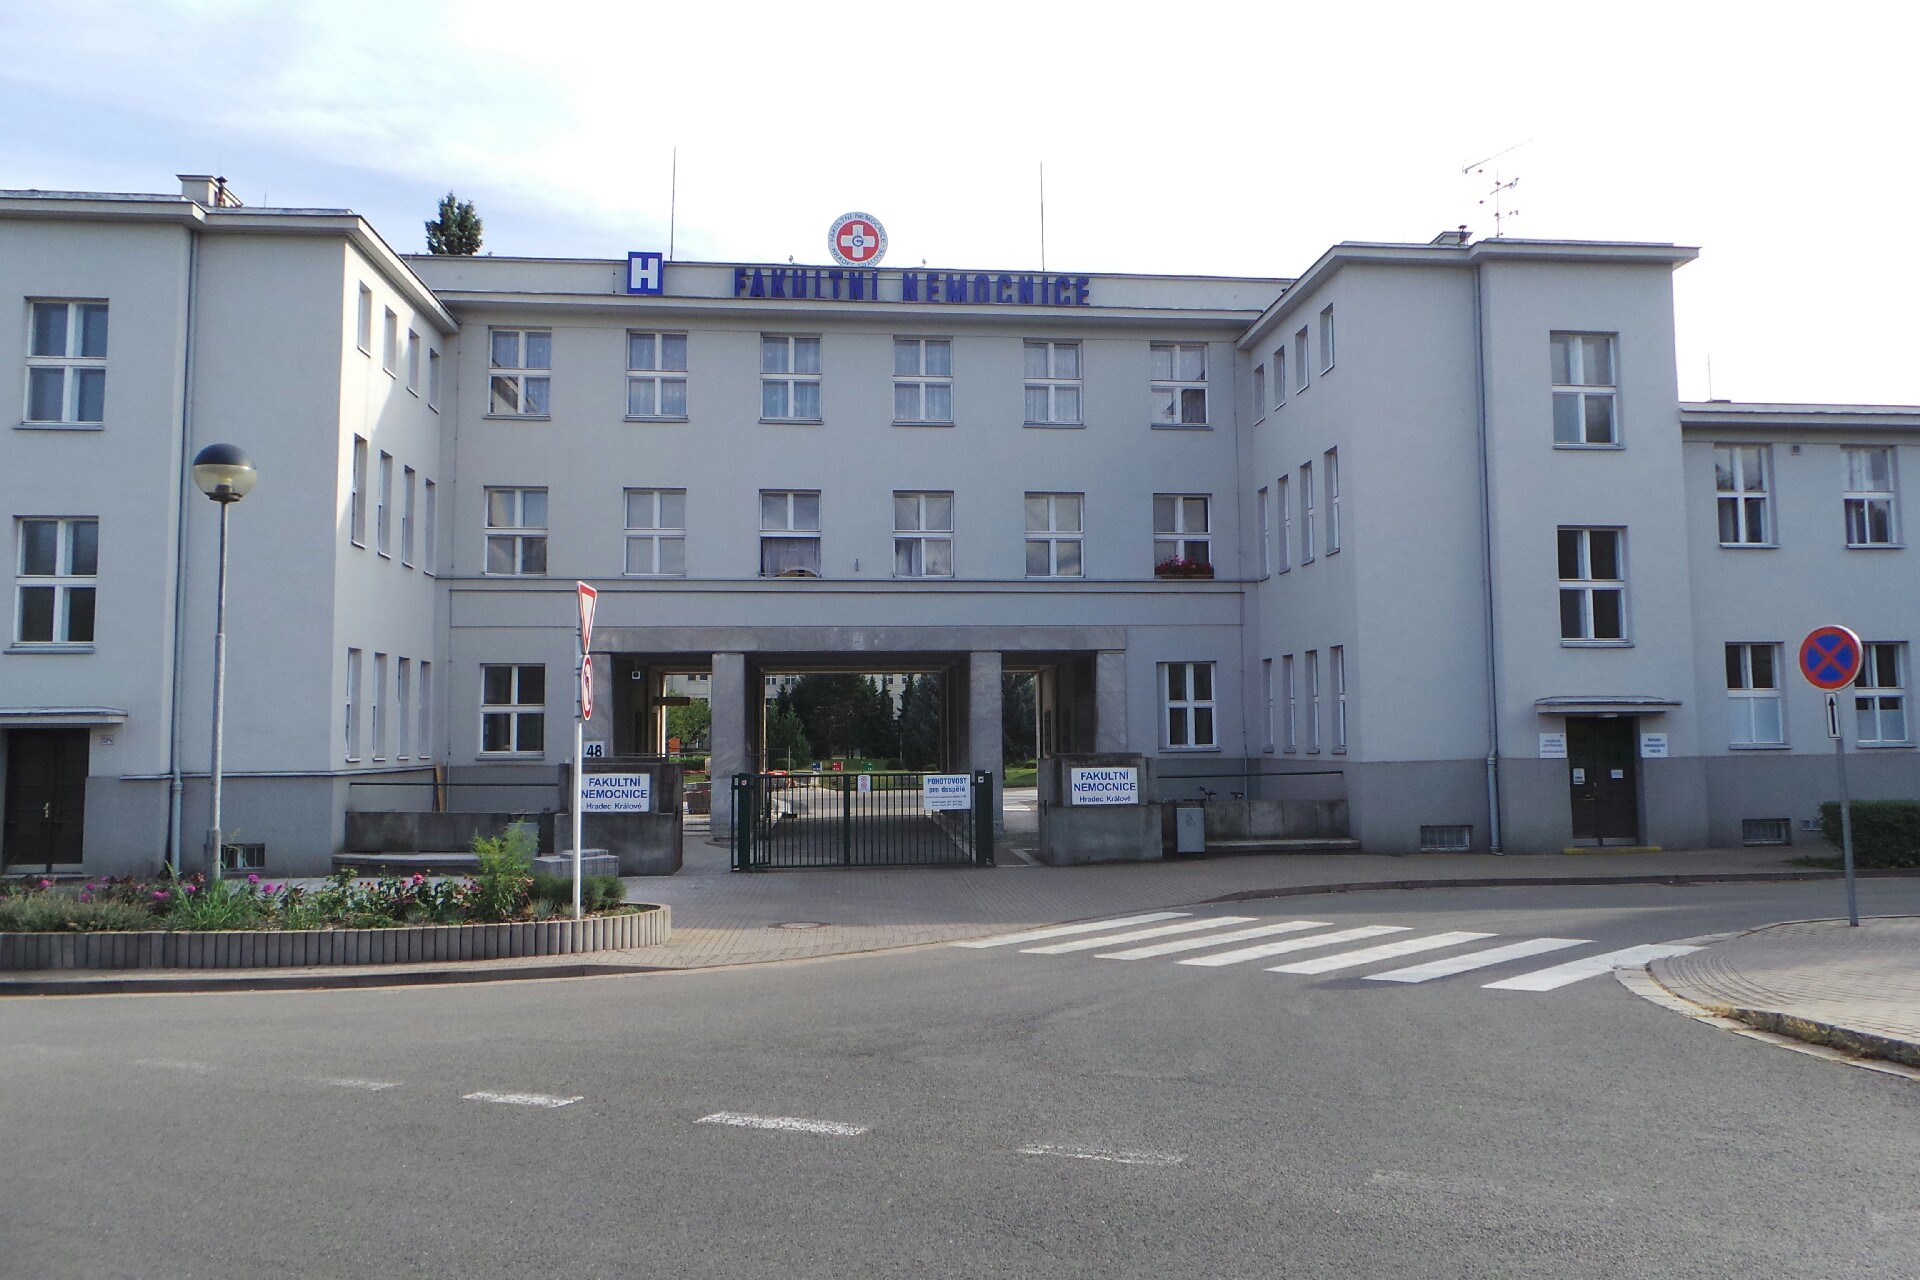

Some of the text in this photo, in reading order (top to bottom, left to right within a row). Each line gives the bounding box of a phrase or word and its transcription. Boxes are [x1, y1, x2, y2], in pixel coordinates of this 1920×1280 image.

[631, 257, 659, 289] H
[902, 272, 1090, 306] NEMOCNICE
[586, 744, 602, 757] 48
[1080, 769, 1129, 781] FAKULTNÍ
[588, 775, 641, 787] FAKULTNÍ
[927, 777, 968, 785] POHOTOVOST
[1073, 782, 1137, 792] NEMOCNICE
[581, 789, 648, 799] NEMOCNICE
[1079, 794, 1132, 803] Hradec Králové
[586, 801, 642, 810] Hradec Králové
